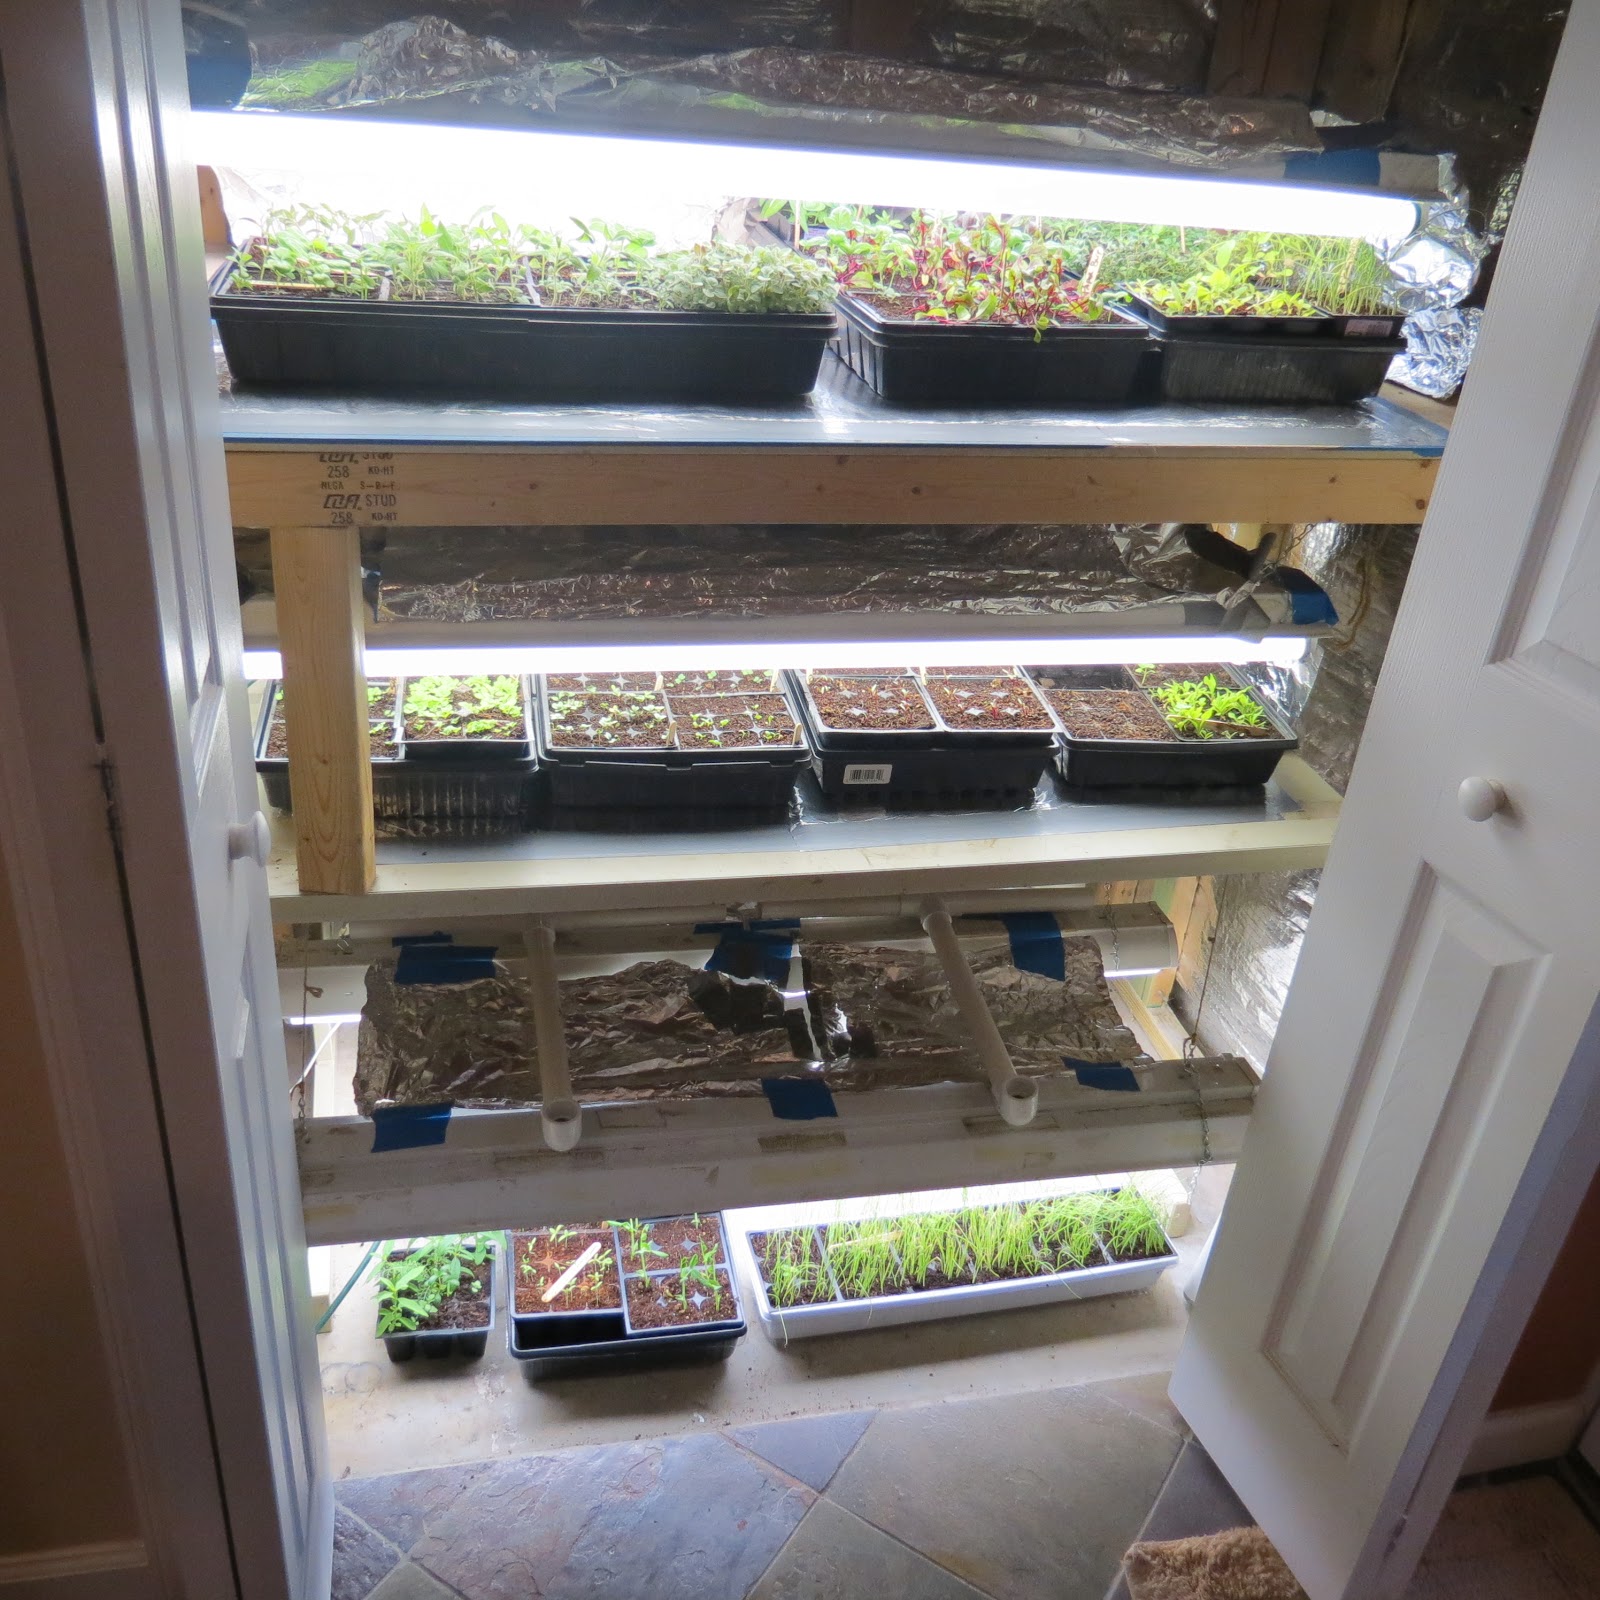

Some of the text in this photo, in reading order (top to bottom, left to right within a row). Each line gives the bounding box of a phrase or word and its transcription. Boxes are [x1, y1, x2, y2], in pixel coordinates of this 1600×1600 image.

[327, 465, 350, 478] 258
[365, 494, 397, 507] STUD
[330, 511, 354, 524] 258
